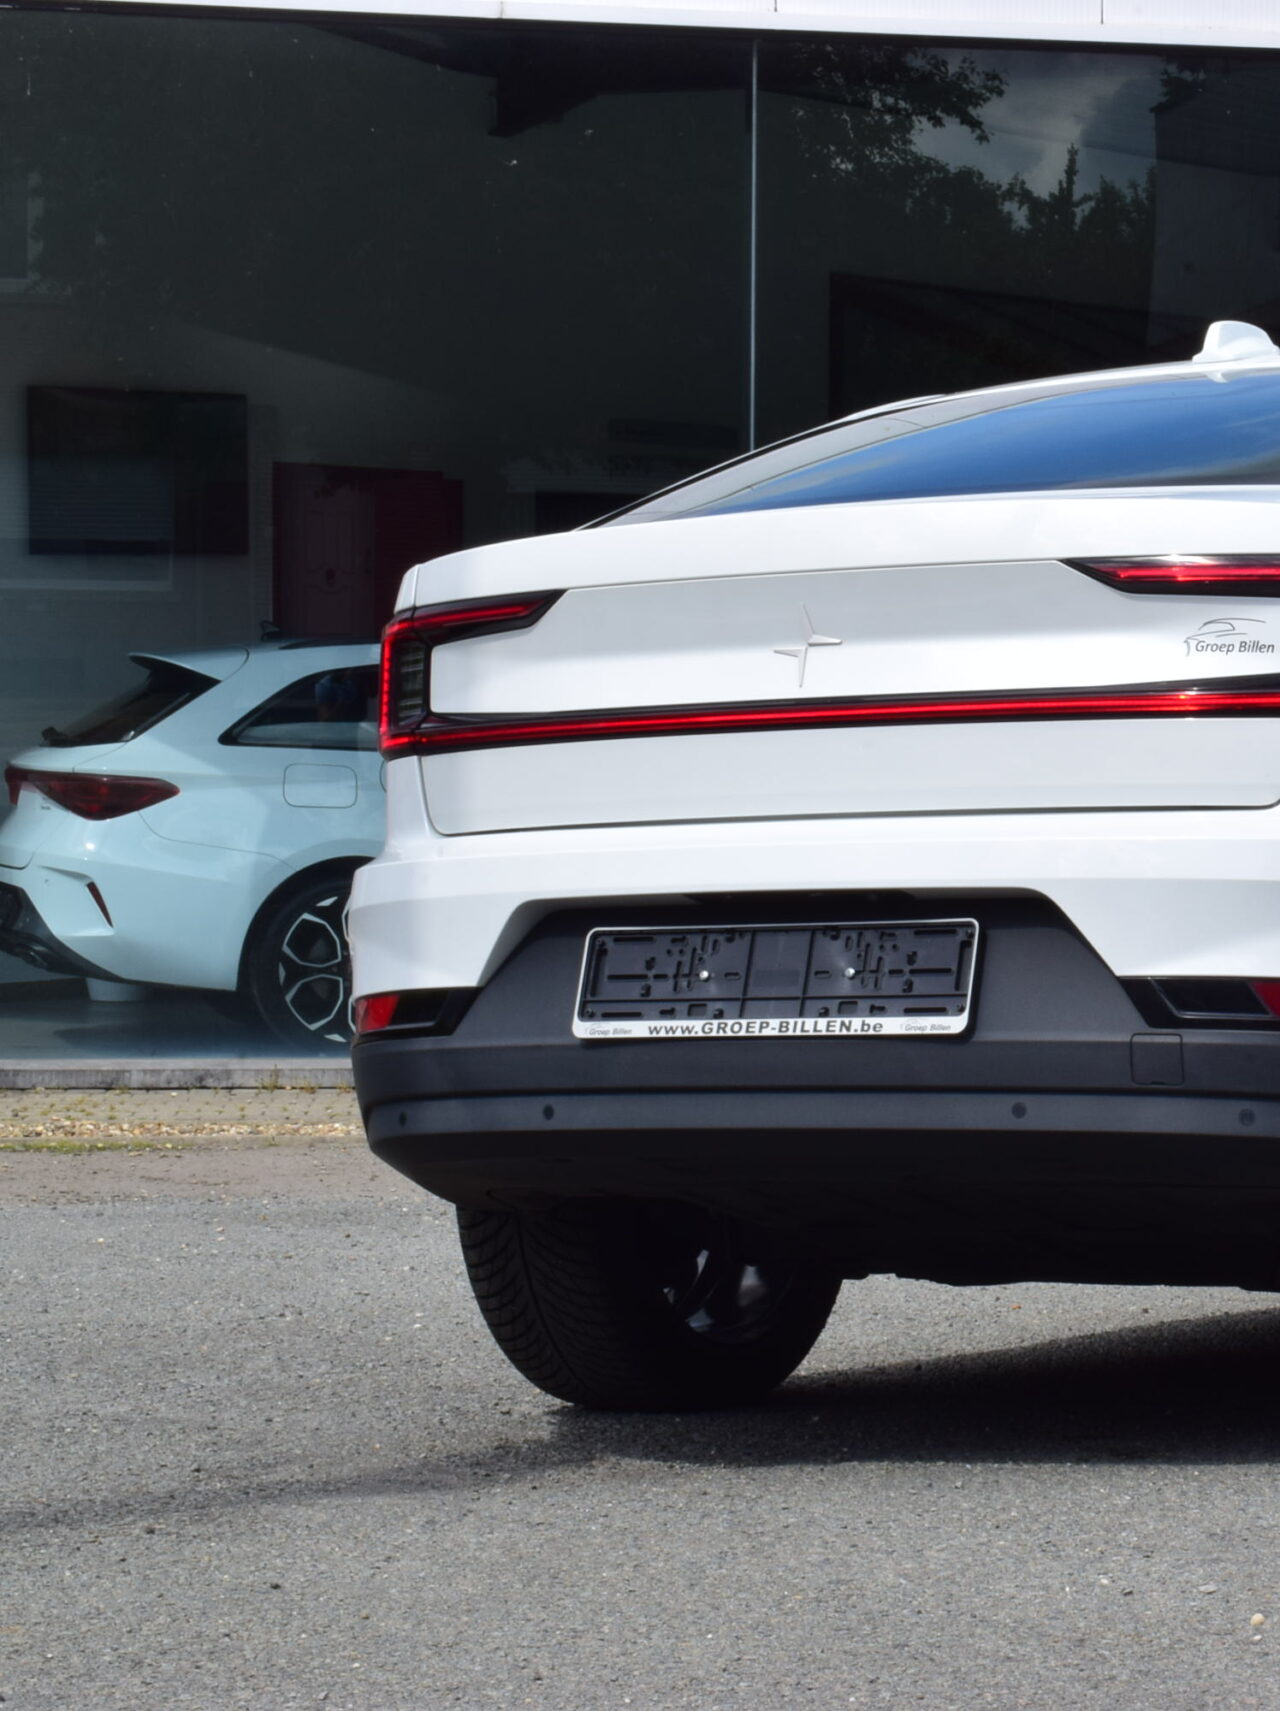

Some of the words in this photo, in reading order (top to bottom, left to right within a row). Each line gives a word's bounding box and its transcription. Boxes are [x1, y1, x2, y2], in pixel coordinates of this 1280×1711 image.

[1195, 640, 1235, 656] Groep
[1238, 640, 1275, 654] Billen
[588, 1028, 610, 1037] Groep
[612, 1027, 633, 1036] Billen
[648, 1019, 884, 1036] www.GROEP-BILLEN.be
[904, 1024, 928, 1034] Groep
[929, 1023, 952, 1032] Billen
